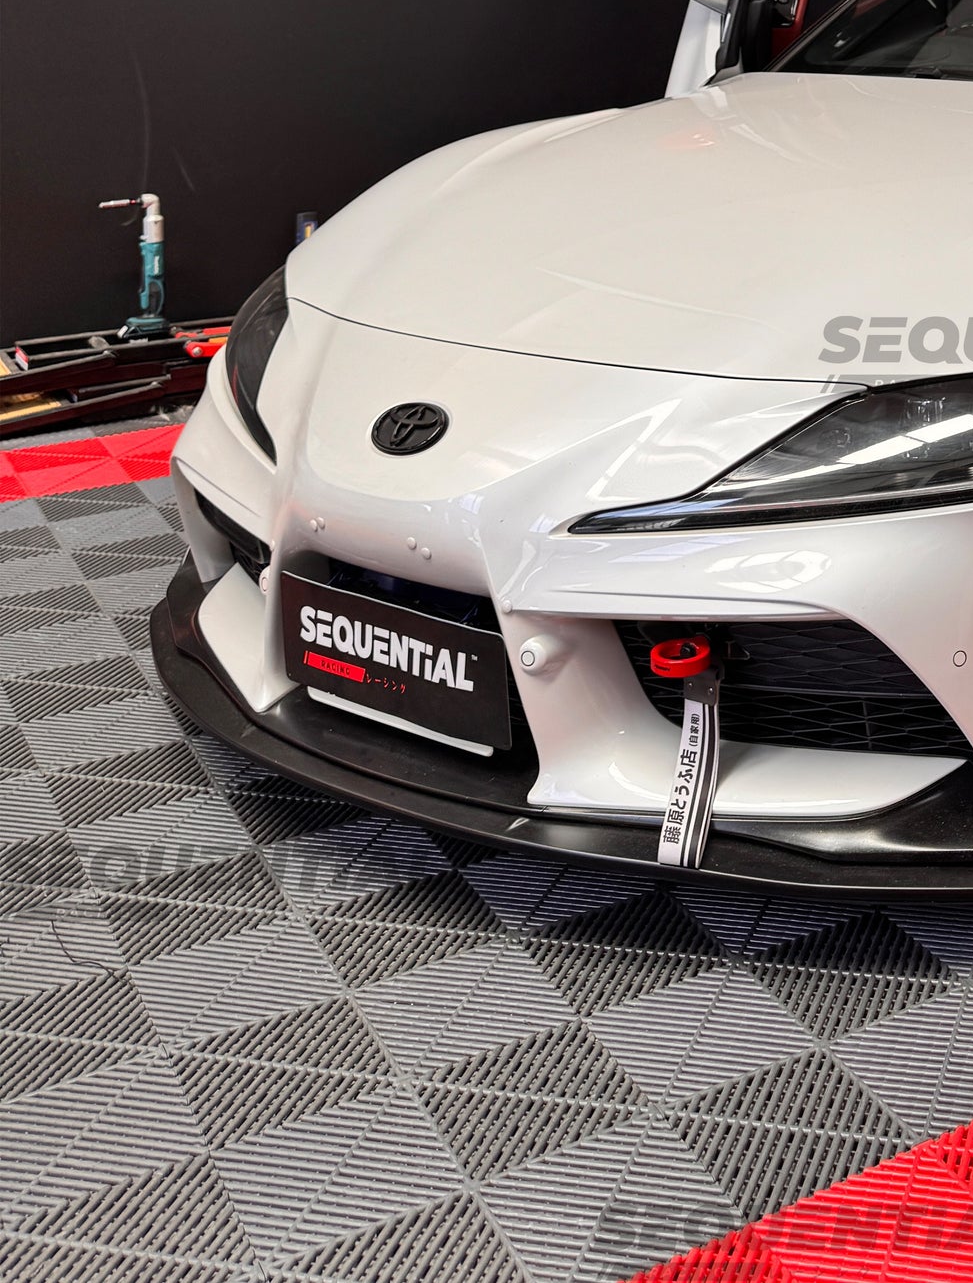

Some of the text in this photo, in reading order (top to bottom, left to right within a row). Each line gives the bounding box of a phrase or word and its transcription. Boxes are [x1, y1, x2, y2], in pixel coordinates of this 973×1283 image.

[663, 749, 698, 845] 藤原とうふ店
